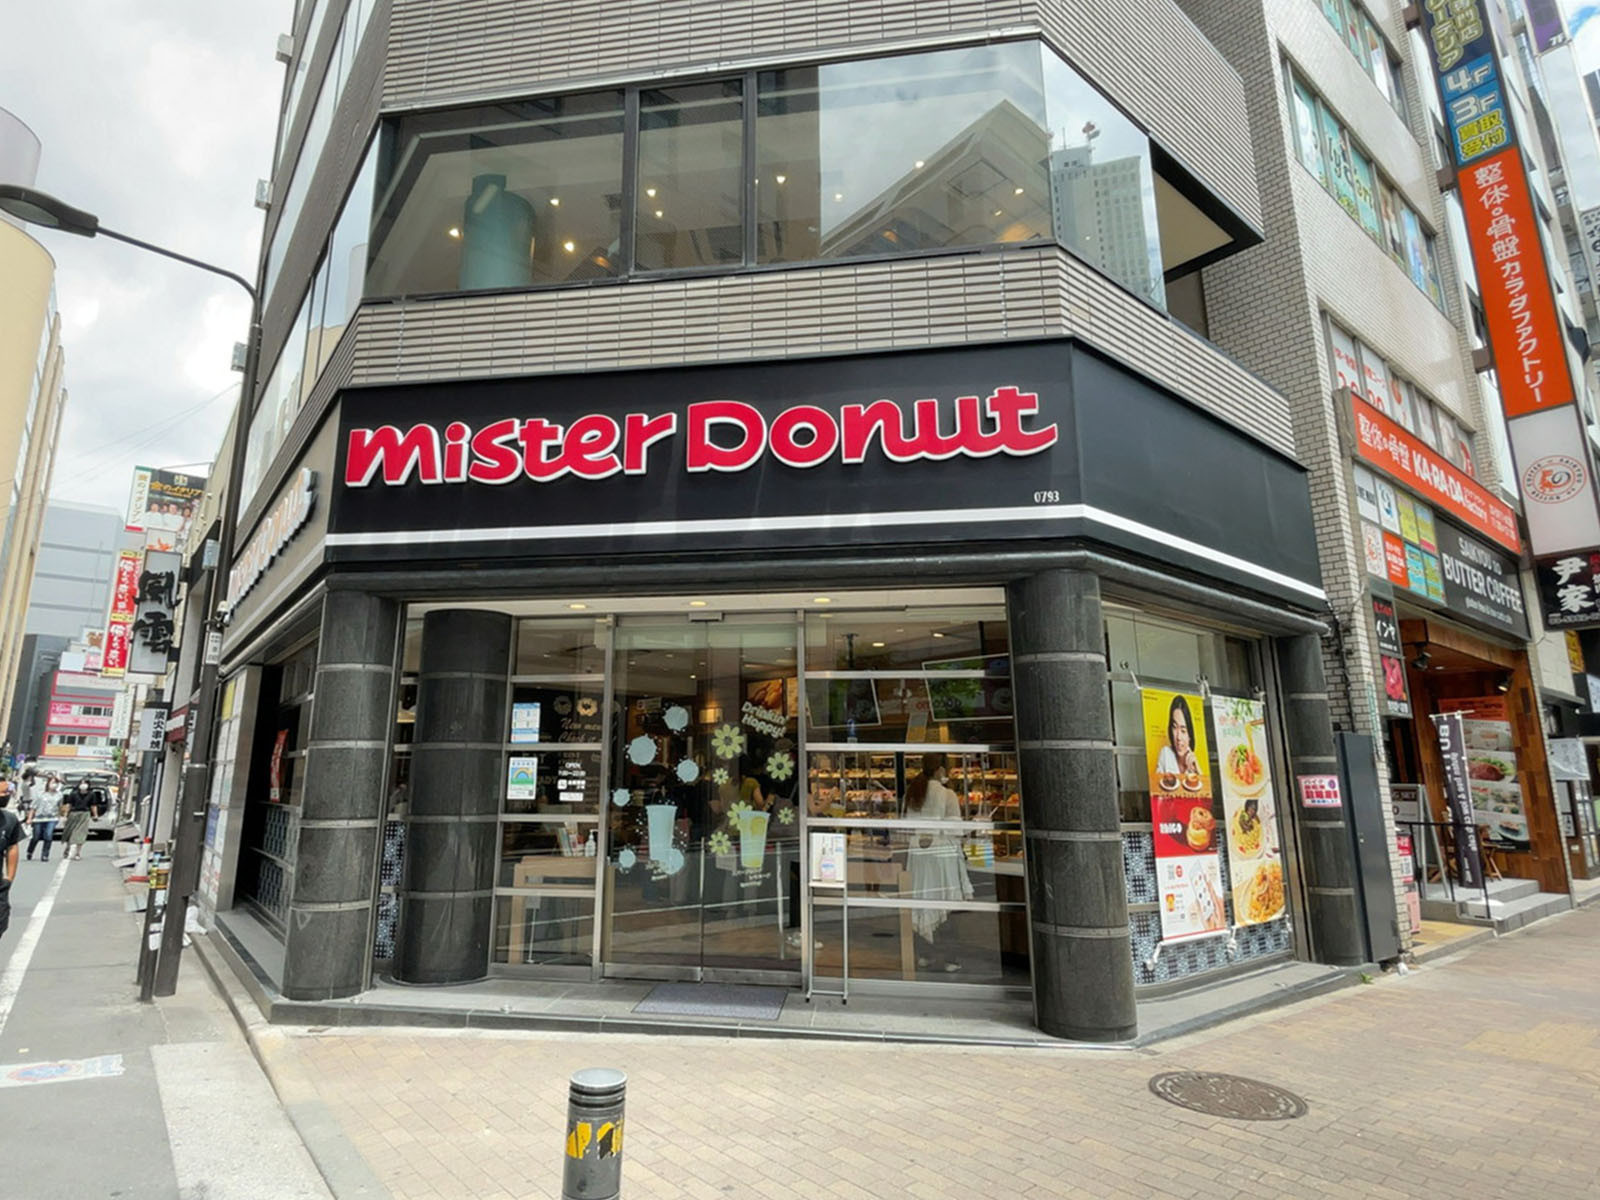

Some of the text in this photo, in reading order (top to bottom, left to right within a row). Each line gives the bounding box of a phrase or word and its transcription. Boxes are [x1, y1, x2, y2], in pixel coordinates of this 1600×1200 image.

[1446, 65, 1491, 91] 4F
[1452, 93, 1496, 123] 3F
[1457, 111, 1502, 140] 買取
[1461, 128, 1506, 160] 受付
[686, 385, 1059, 474] Donut
[1033, 490, 1060, 503] 0793
[1442, 552, 1487, 597] BUTTER
[1487, 575, 1523, 614] COFFEE
